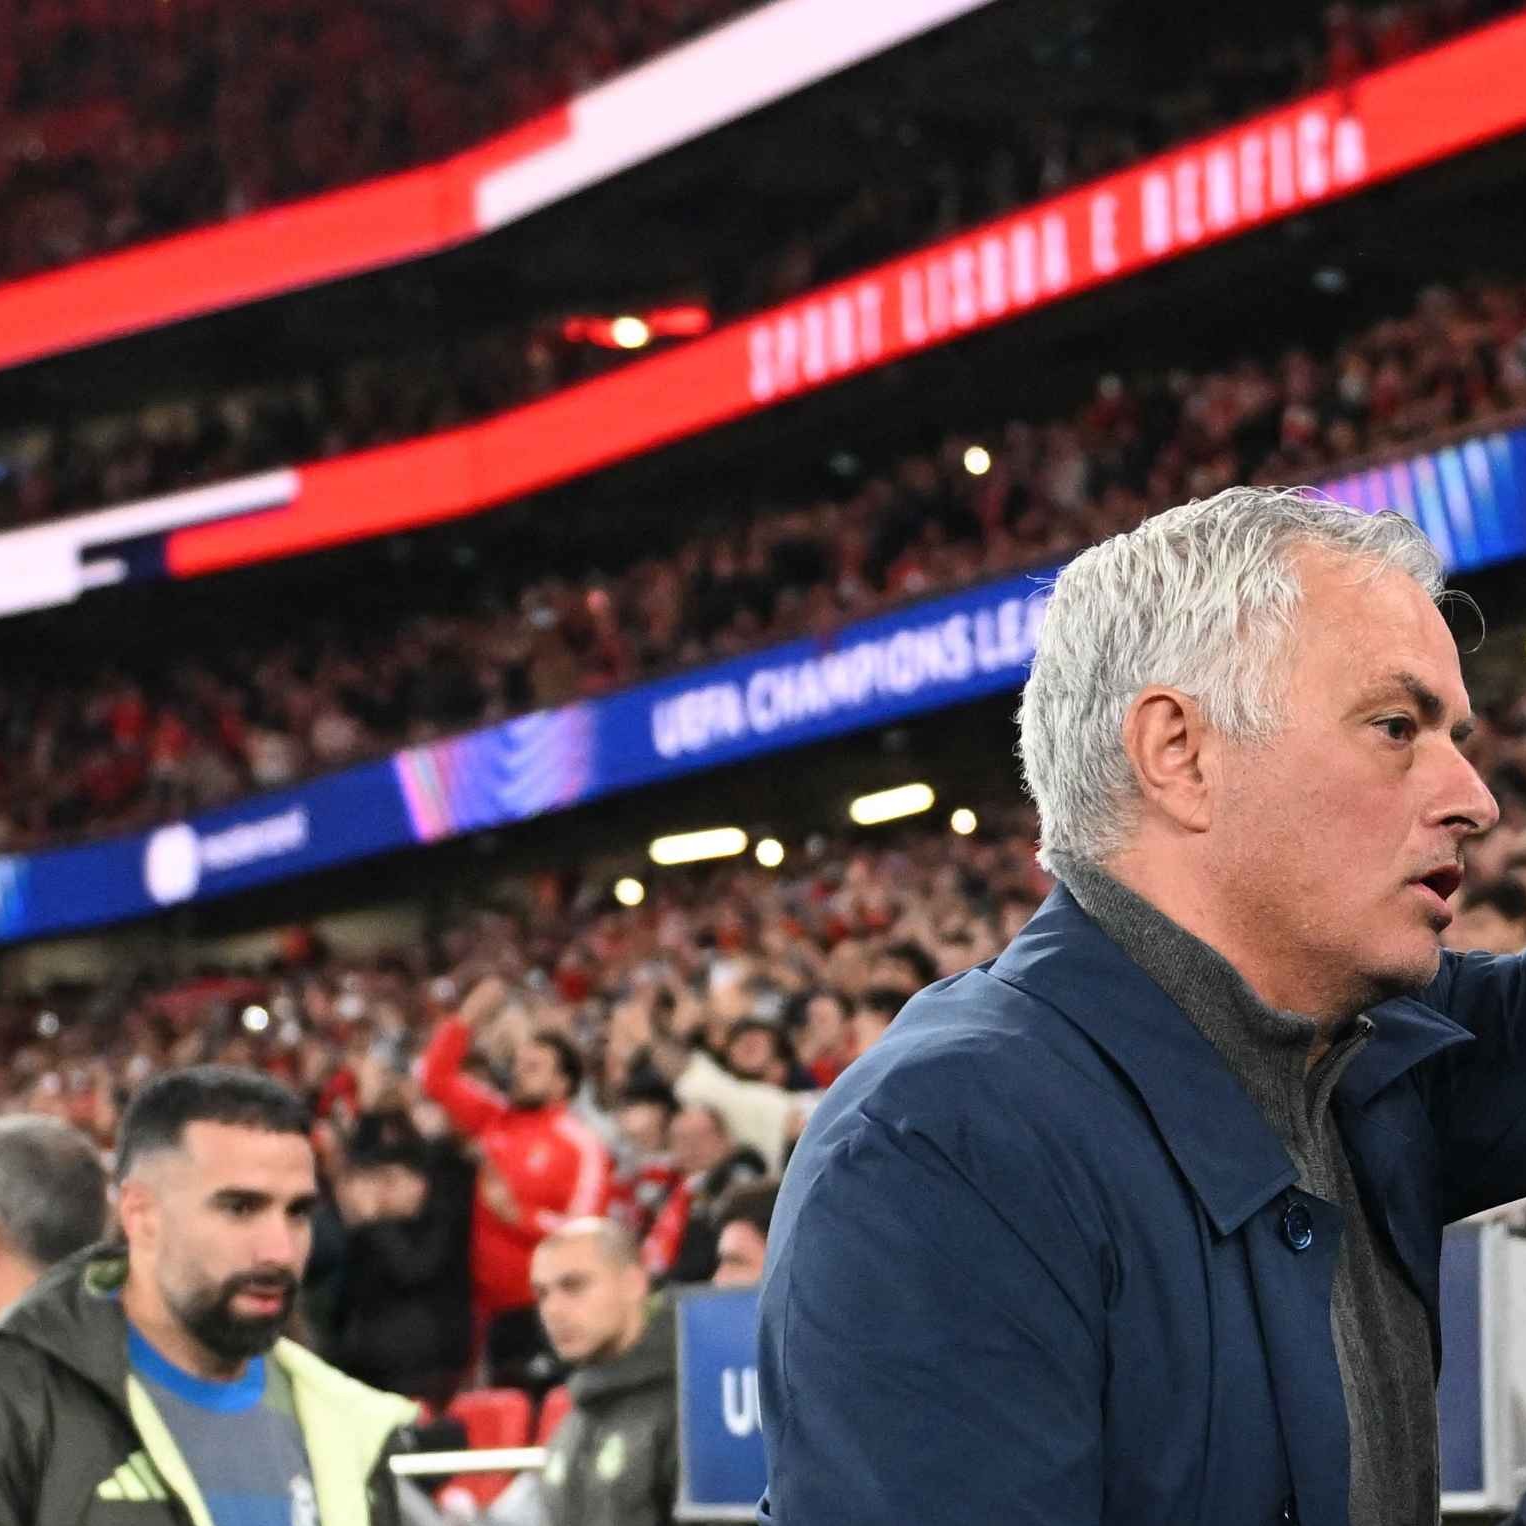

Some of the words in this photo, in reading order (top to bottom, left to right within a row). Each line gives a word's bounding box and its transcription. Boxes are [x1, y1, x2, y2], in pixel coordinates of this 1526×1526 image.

[749, 284, 883, 402] SPORT
[900, 212, 1072, 346] LISBOA
[1090, 192, 1119, 276] E
[1140, 109, 1367, 258] BENFICA
[650, 680, 746, 760] UEFA
[746, 613, 973, 735] CHAMPIONS
[975, 596, 1049, 674] LEA
[721, 1366, 759, 1437] U
